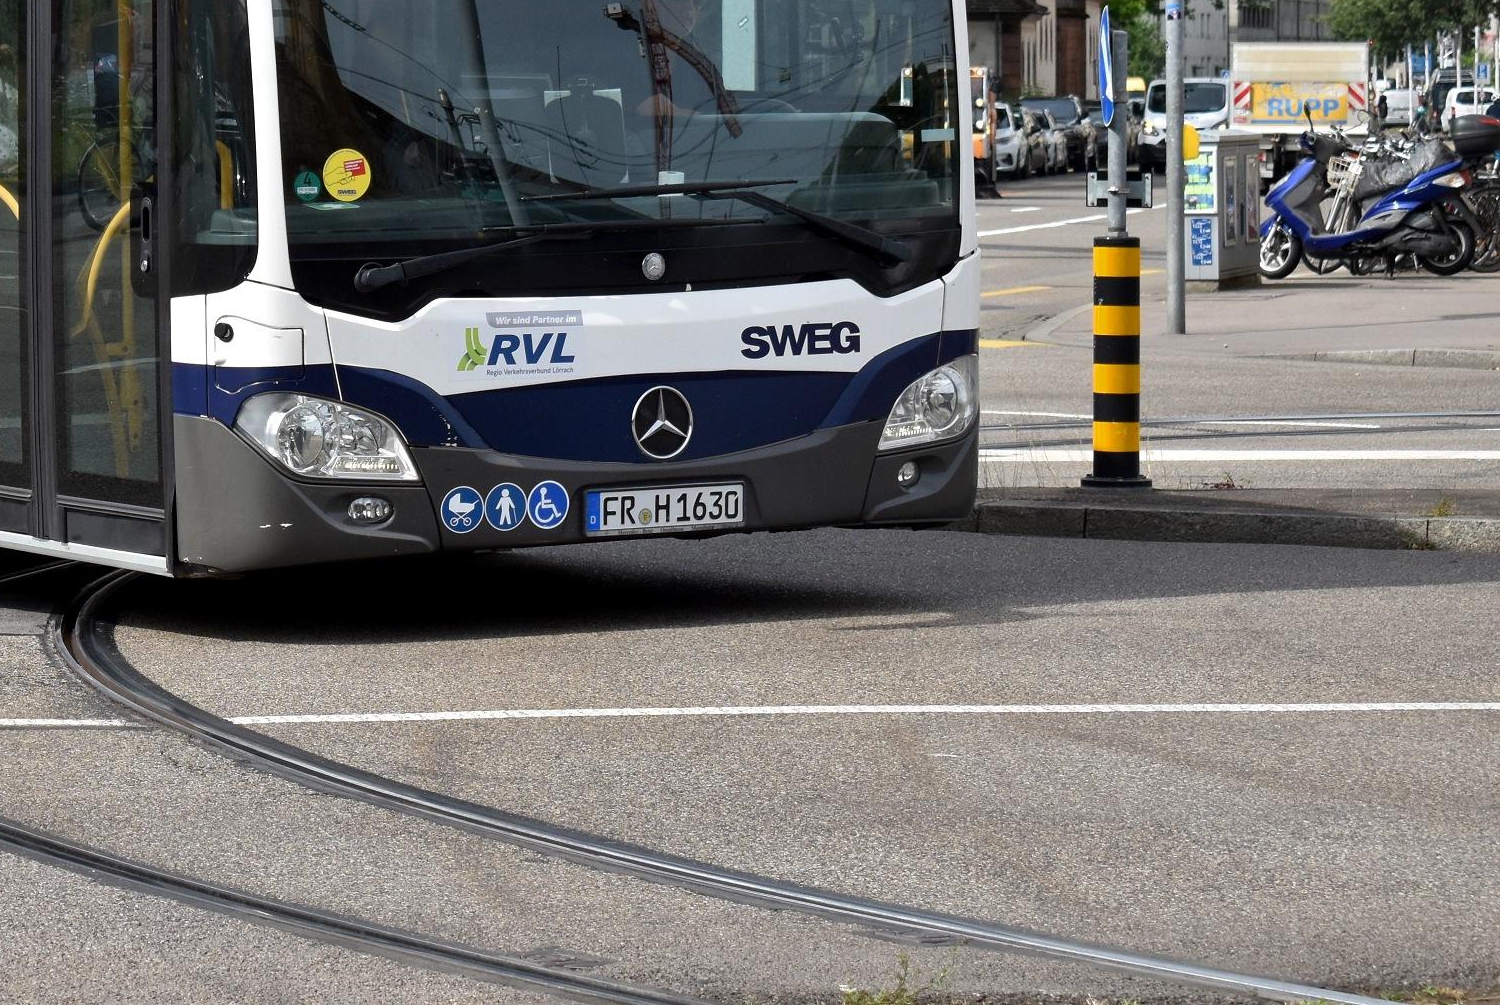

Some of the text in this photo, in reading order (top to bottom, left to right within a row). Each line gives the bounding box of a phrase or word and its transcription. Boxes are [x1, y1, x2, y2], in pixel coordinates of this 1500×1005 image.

[1267, 98, 1340, 117] RUPP
[495, 314, 577, 325] Wir sind Partner im
[487, 332, 576, 366] RVL
[741, 321, 861, 360] SWEG
[486, 369, 503, 378] Regio
[504, 367, 551, 375] Verkehrsverbund
[589, 515, 596, 525] D
[603, 495, 636, 526] FR
